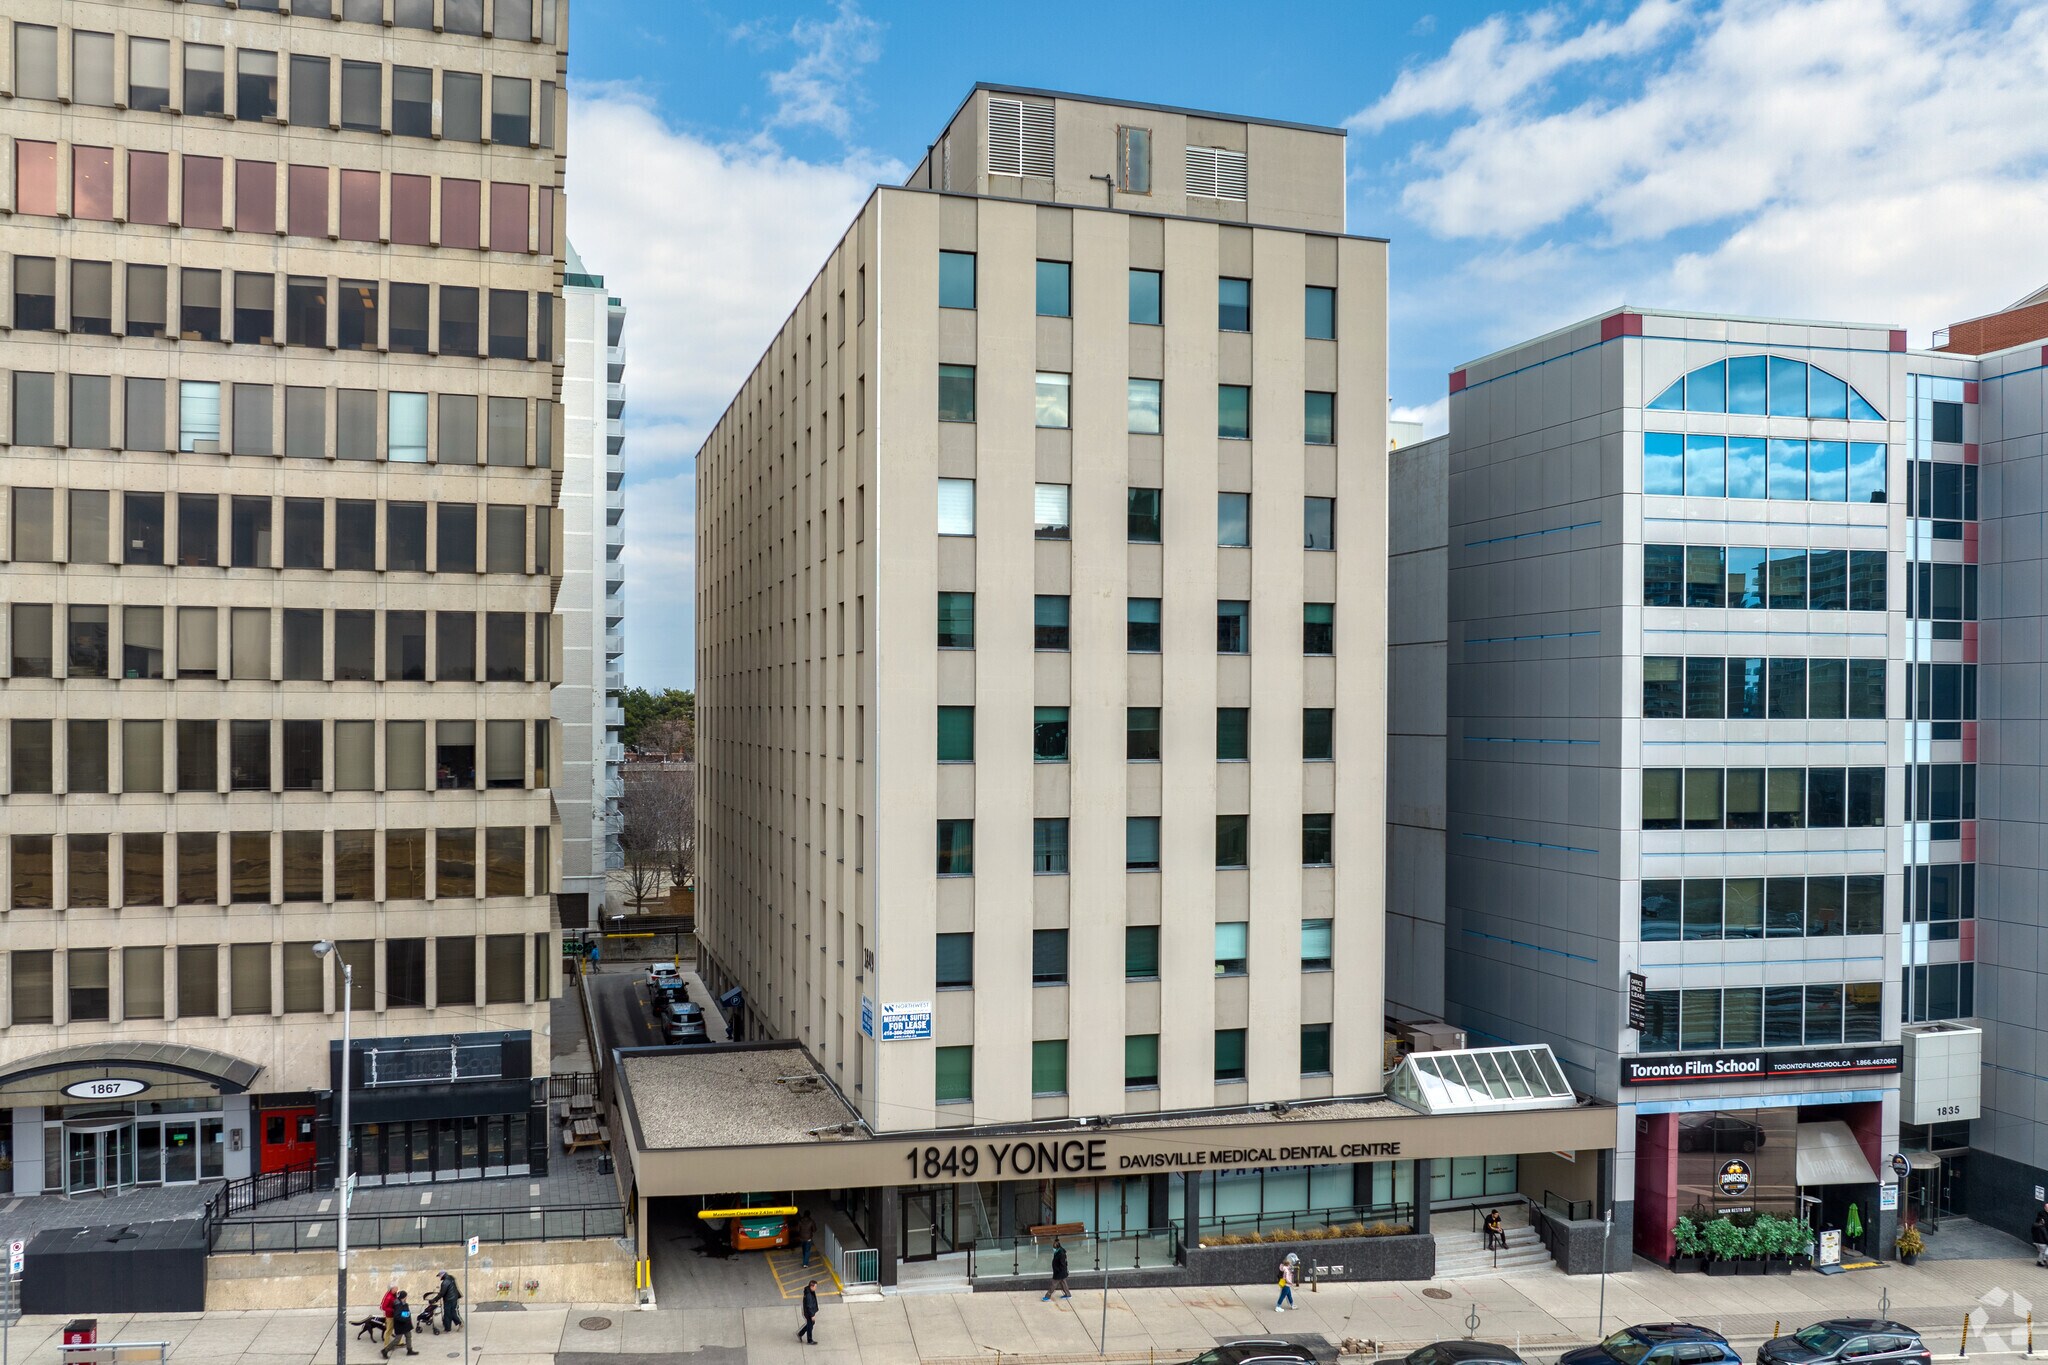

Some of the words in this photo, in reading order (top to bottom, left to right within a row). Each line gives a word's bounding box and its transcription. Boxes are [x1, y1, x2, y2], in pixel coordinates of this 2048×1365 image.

[883, 1014, 909, 1022] MEDICAL
[889, 1022, 904, 1031] FOR
[905, 1020, 927, 1030] LEASE
[1630, 1063, 1683, 1077] Toronto
[1685, 1060, 1713, 1075] Film
[1715, 1058, 1760, 1073] School
[1774, 1060, 1851, 1070] TORONTOFILMSCHOOL.CA
[91, 1083, 121, 1094] 1867
[1937, 1105, 1960, 1116] 1835
[907, 1145, 979, 1179] 1849
[988, 1139, 1107, 1175] YONGE
[1119, 1151, 1207, 1169] DAVISVILLE
[1210, 1147, 1276, 1164] MEDICAL
[1280, 1145, 1337, 1160] DENTAL
[1340, 1142, 1401, 1157] CENTRE
[1721, 1173, 1748, 1184] TAMASHA
